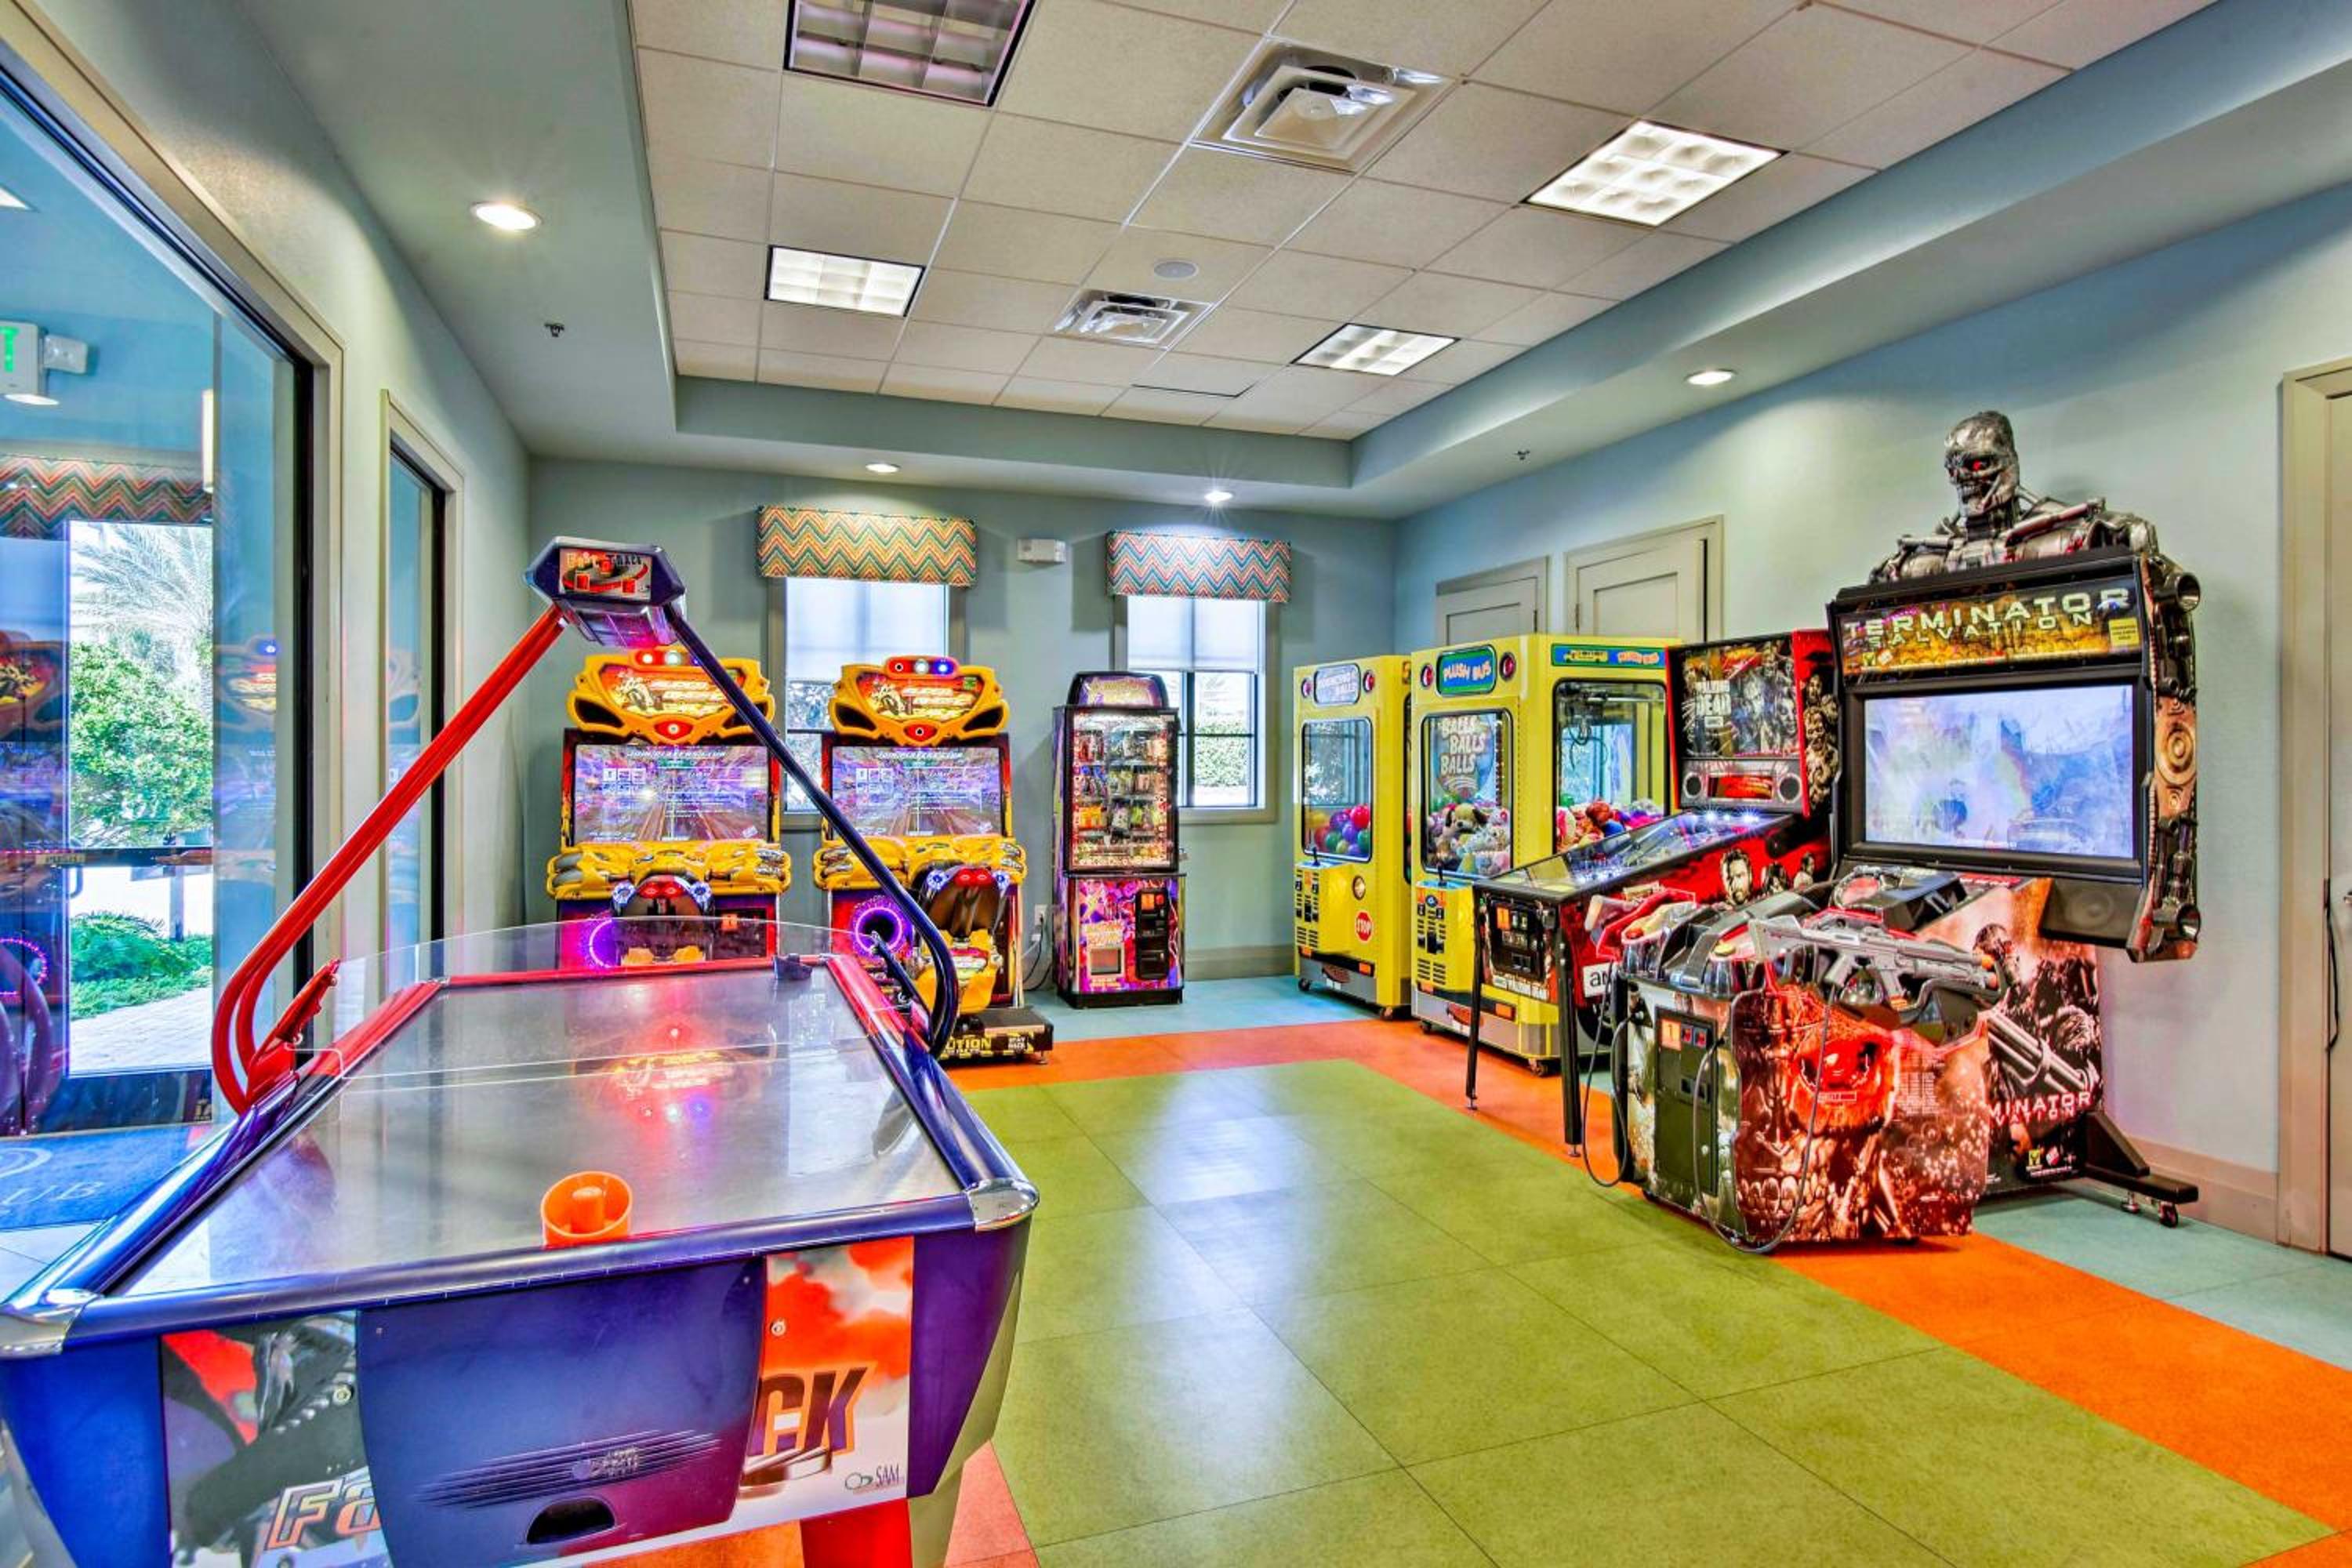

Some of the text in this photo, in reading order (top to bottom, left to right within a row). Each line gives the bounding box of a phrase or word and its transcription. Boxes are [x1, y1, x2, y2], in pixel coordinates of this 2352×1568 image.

[1843, 588, 2129, 640] TERMINATOR
[1867, 611, 2092, 648] SALVATION
[1449, 733, 1486, 755] BALLS
[1440, 753, 1476, 775] BALLS
[946, 1036, 991, 1050] UTION
[1988, 1091, 2092, 1119] MINATOR
[1994, 1104, 2075, 1127] VATION
[0, 1180, 105, 1205] UB
[746, 1367, 869, 1457] CK
